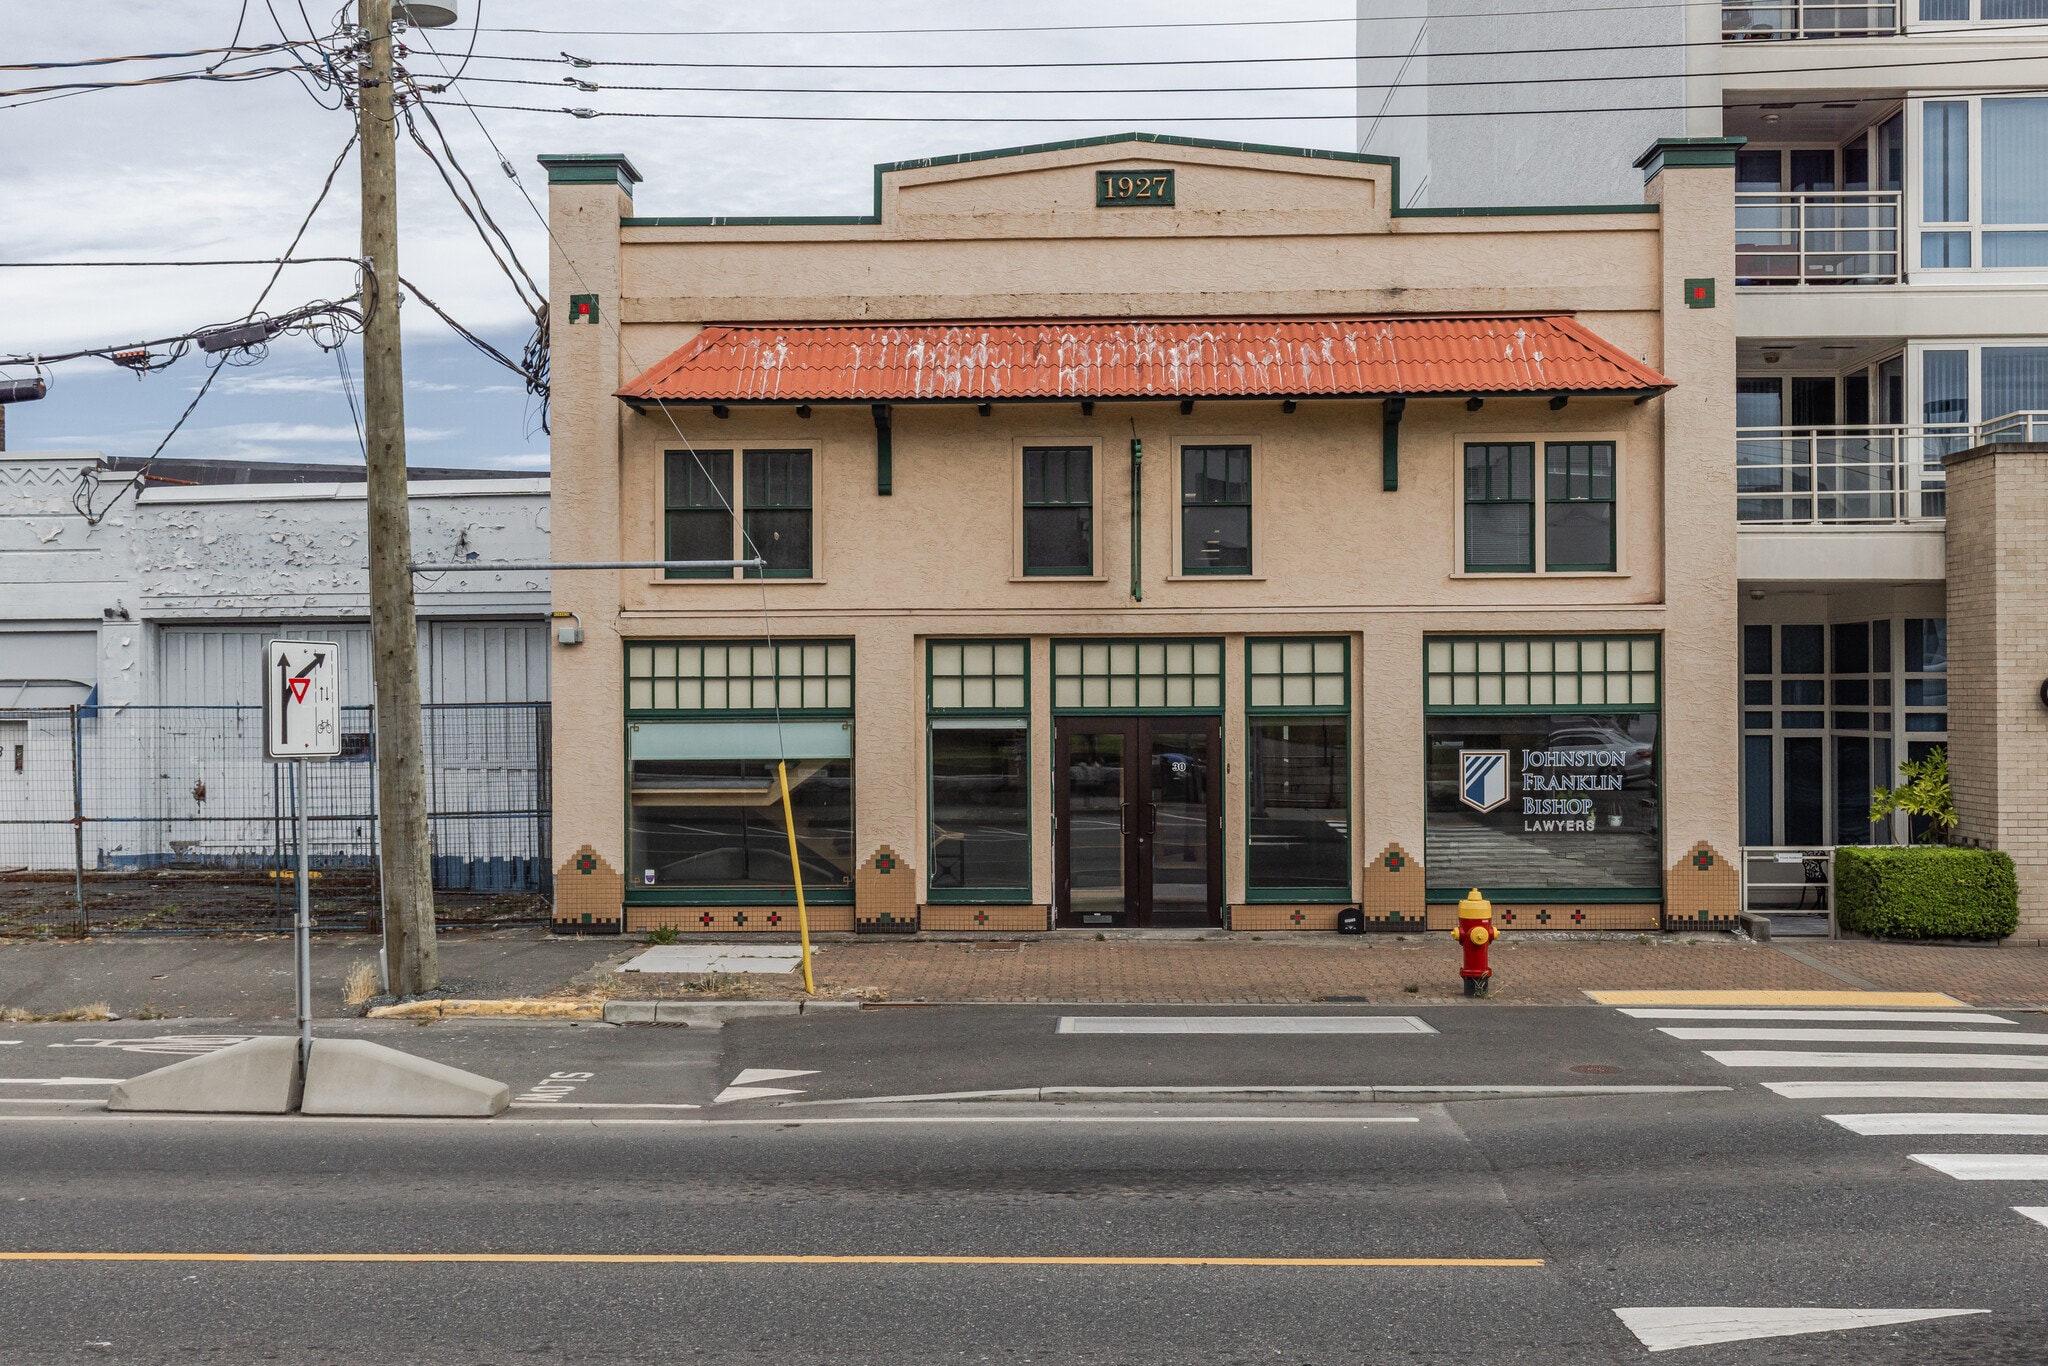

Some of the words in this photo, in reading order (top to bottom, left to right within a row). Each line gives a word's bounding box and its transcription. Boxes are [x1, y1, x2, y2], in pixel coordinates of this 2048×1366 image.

[1103, 176, 1167, 198] 1927
[1171, 761, 1187, 772] 30
[1521, 749, 1626, 771] JOHNSTON
[1522, 773, 1623, 791] FRANKLIN
[1522, 797, 1593, 815] BISHOP
[1524, 820, 1595, 832] LAWYERS
[514, 1071, 595, 1102] SLOW
